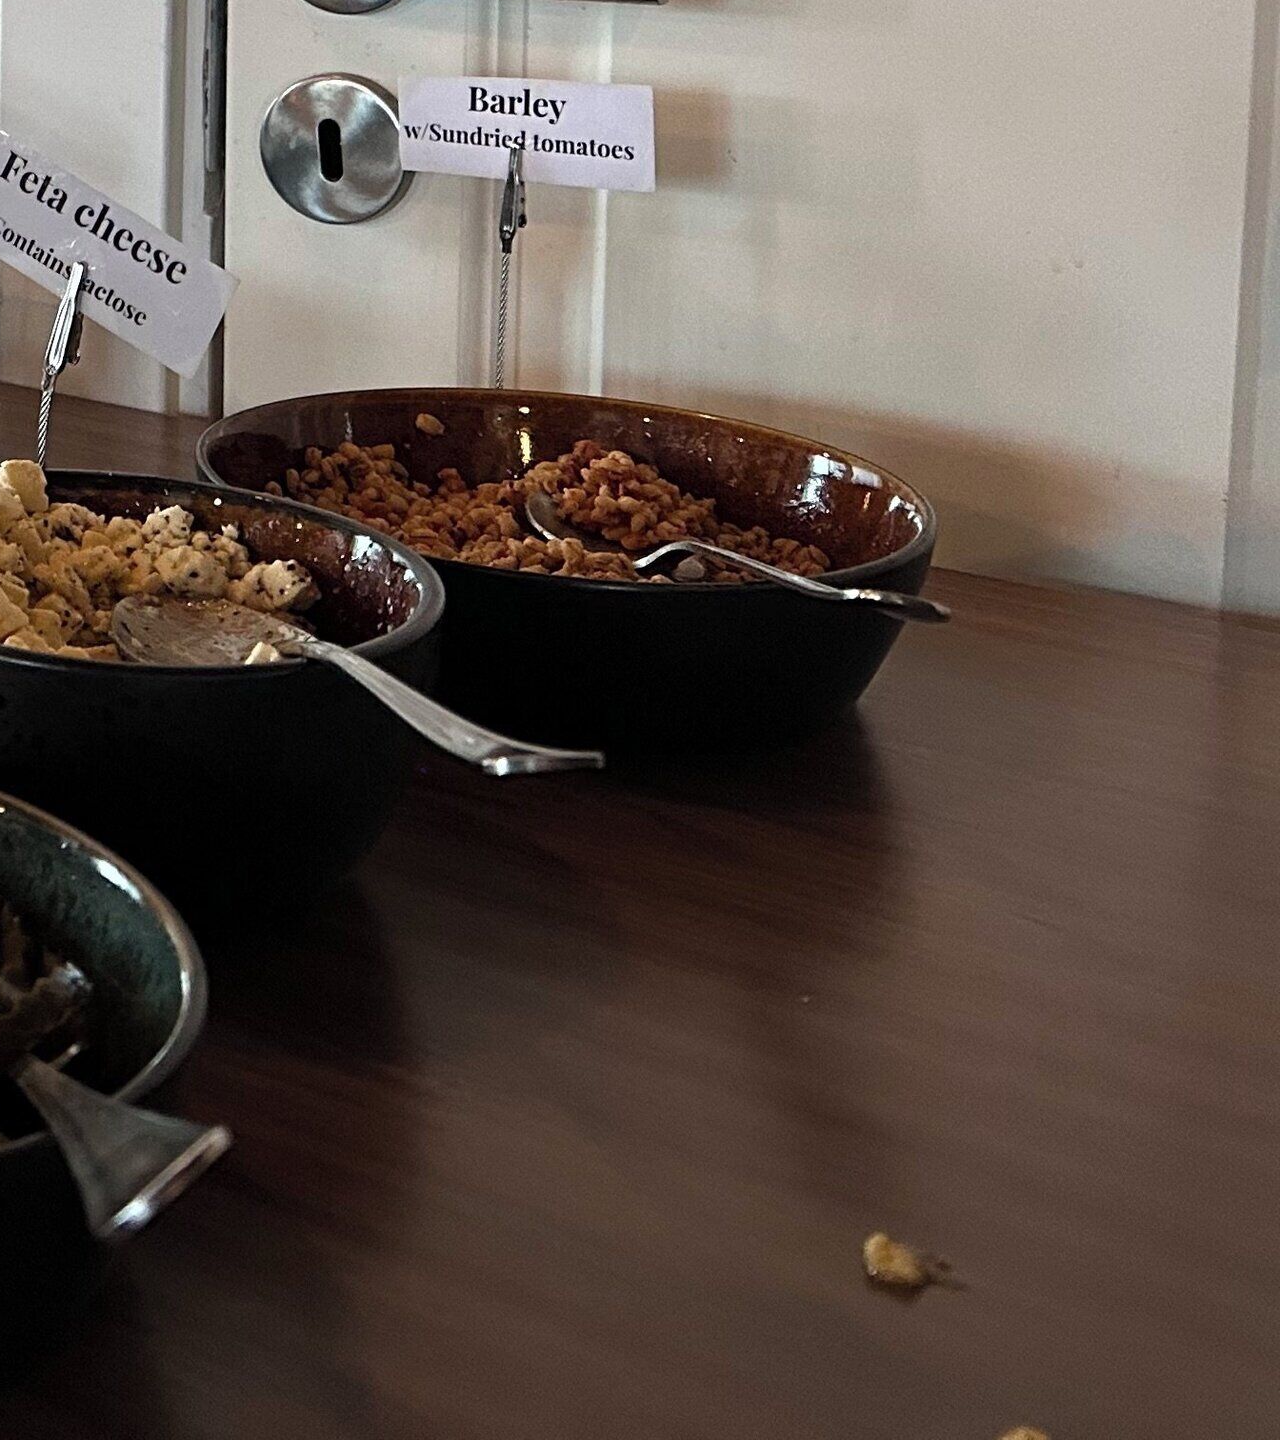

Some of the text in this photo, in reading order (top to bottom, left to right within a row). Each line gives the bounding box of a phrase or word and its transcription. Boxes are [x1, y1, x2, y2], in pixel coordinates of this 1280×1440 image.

[468, 85, 567, 125] Barley
[403, 122, 635, 161] w/Sundried tomatoes
[74, 203, 187, 285] cheese
[77, 272, 147, 327] actose
